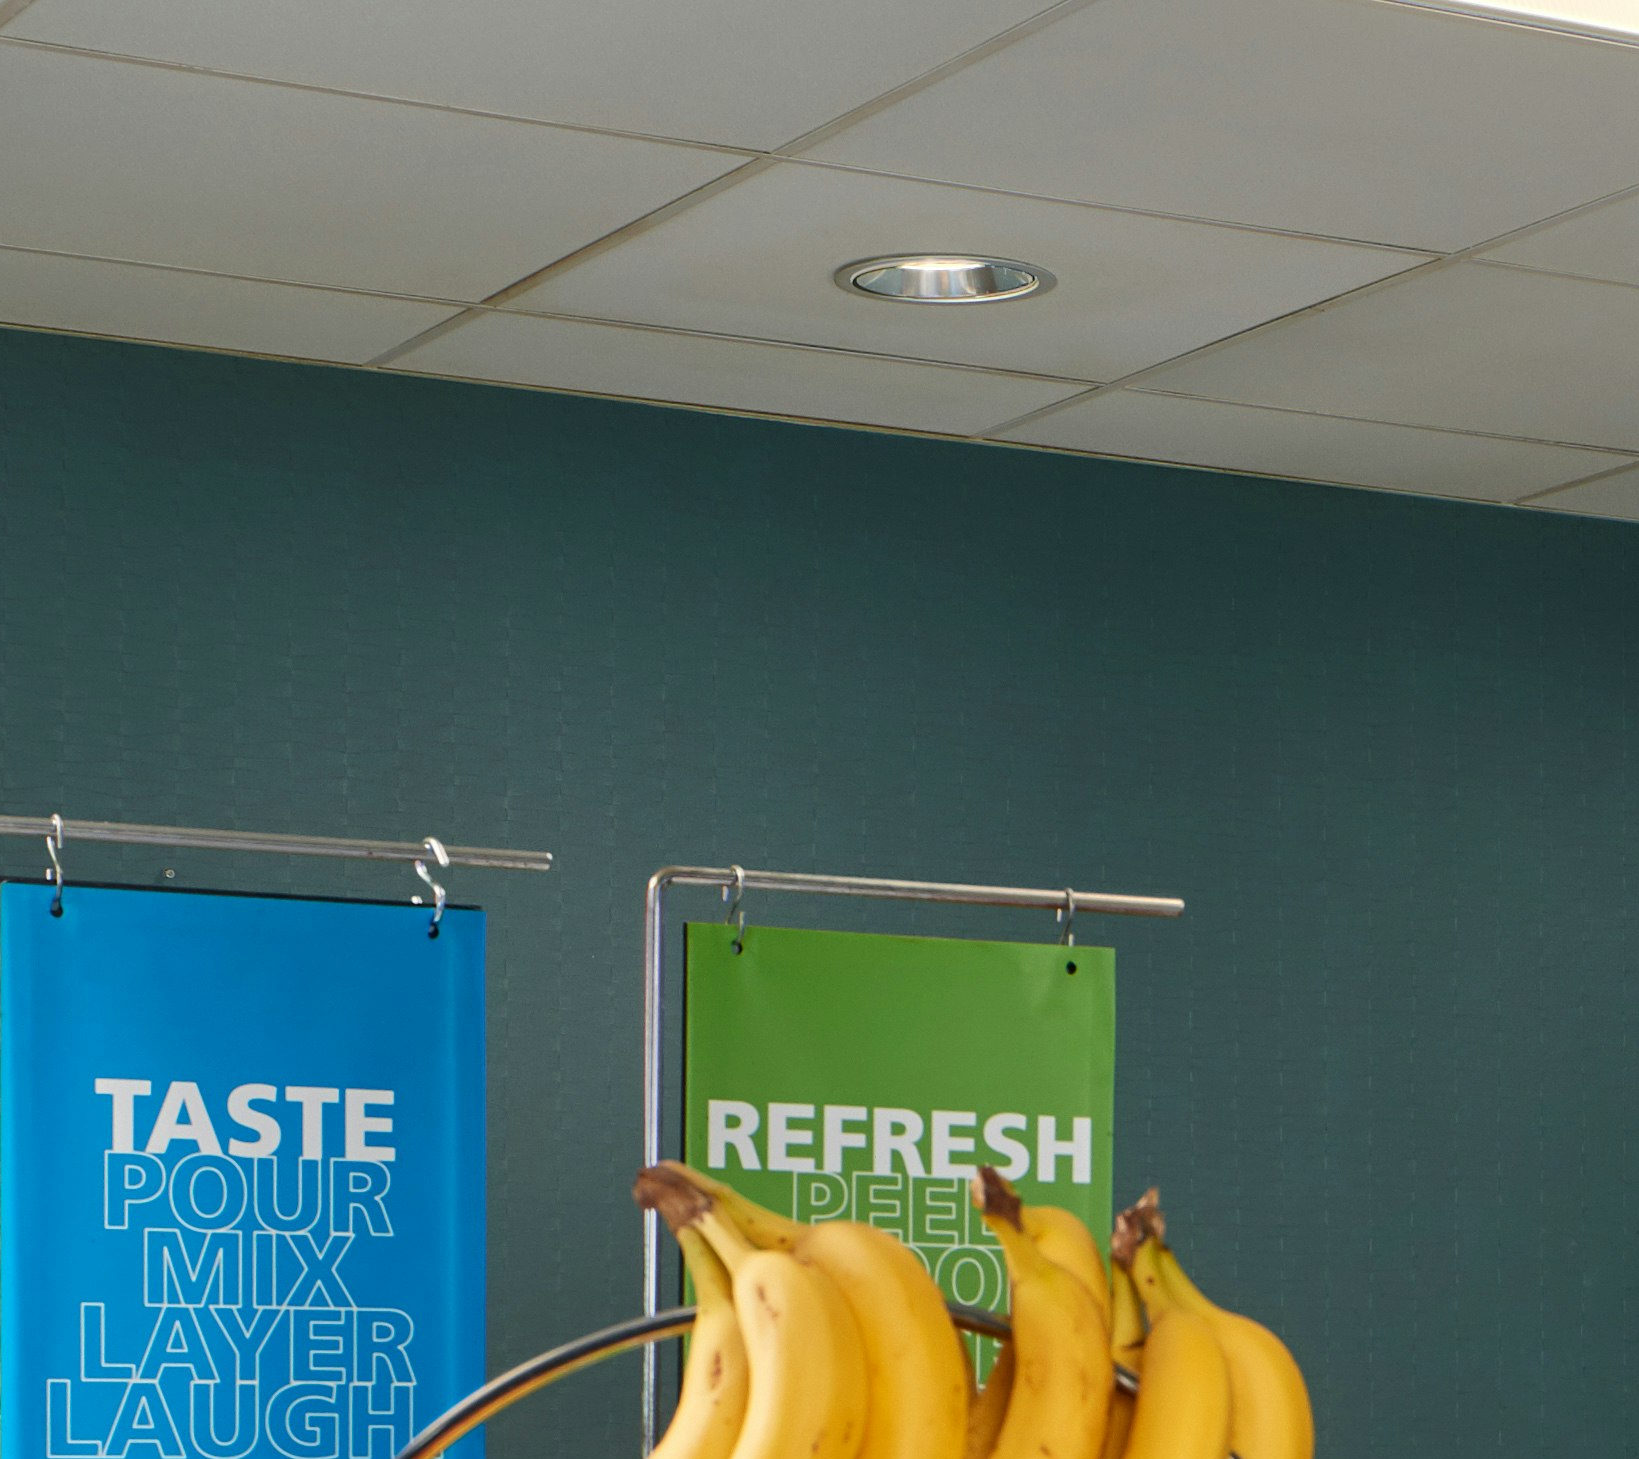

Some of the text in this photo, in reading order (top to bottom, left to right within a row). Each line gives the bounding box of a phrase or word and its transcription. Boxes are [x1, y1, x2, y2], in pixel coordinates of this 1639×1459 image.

[94, 1077, 396, 1161] TASTE
[708, 1098, 1092, 1184] REFRESH
[104, 1149, 393, 1236] POUR
[144, 1228, 358, 1310] MIX
[81, 1302, 417, 1385] LAYER
